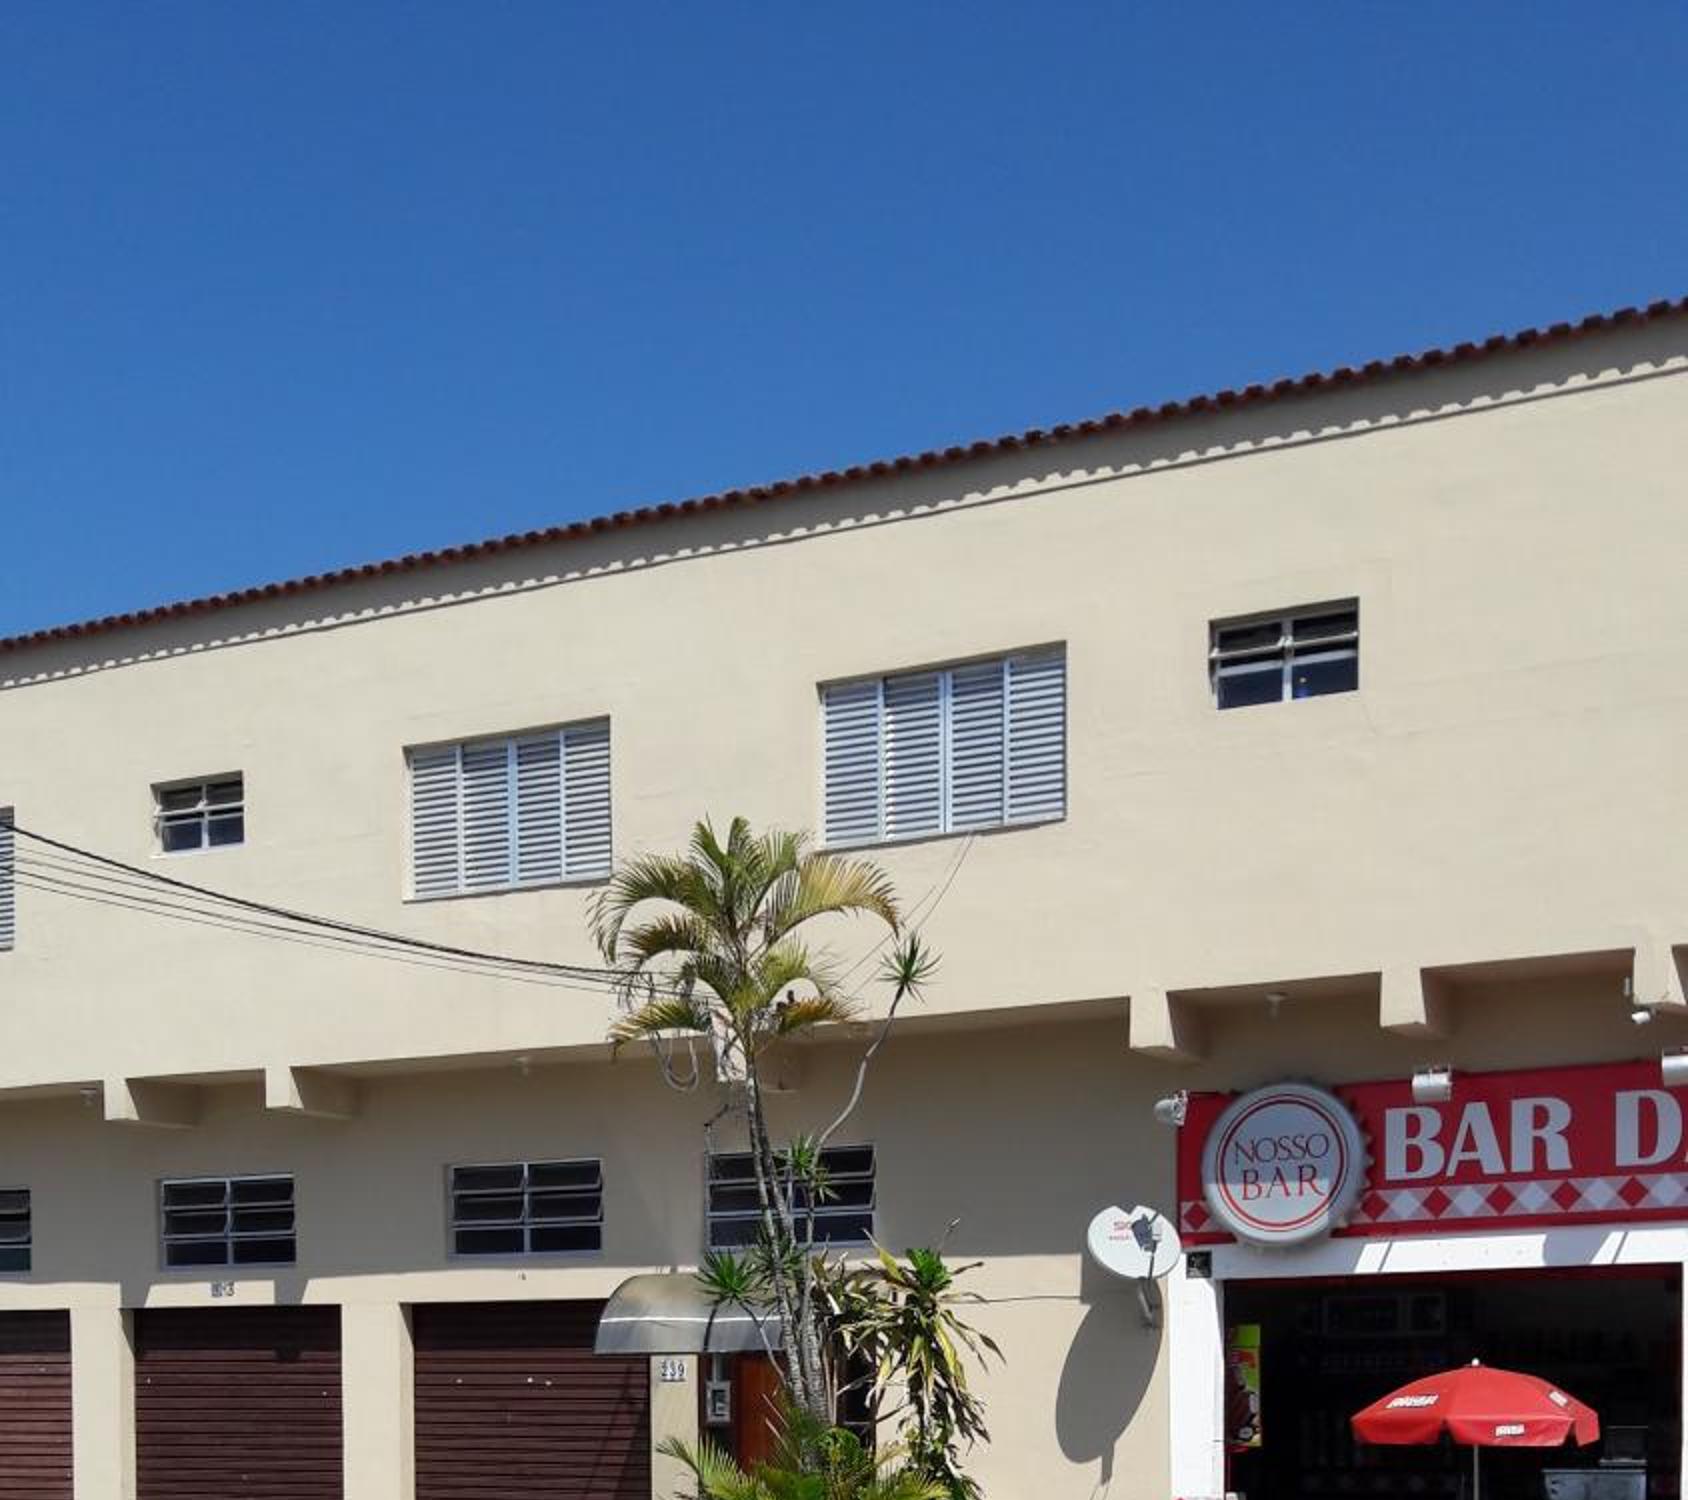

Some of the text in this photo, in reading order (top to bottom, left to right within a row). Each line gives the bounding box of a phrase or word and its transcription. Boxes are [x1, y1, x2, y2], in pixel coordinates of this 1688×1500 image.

[1233, 1132, 1330, 1164] NOSSO
[1384, 1088, 1688, 1182] BAR D
[1241, 1164, 1326, 1201] BAR
